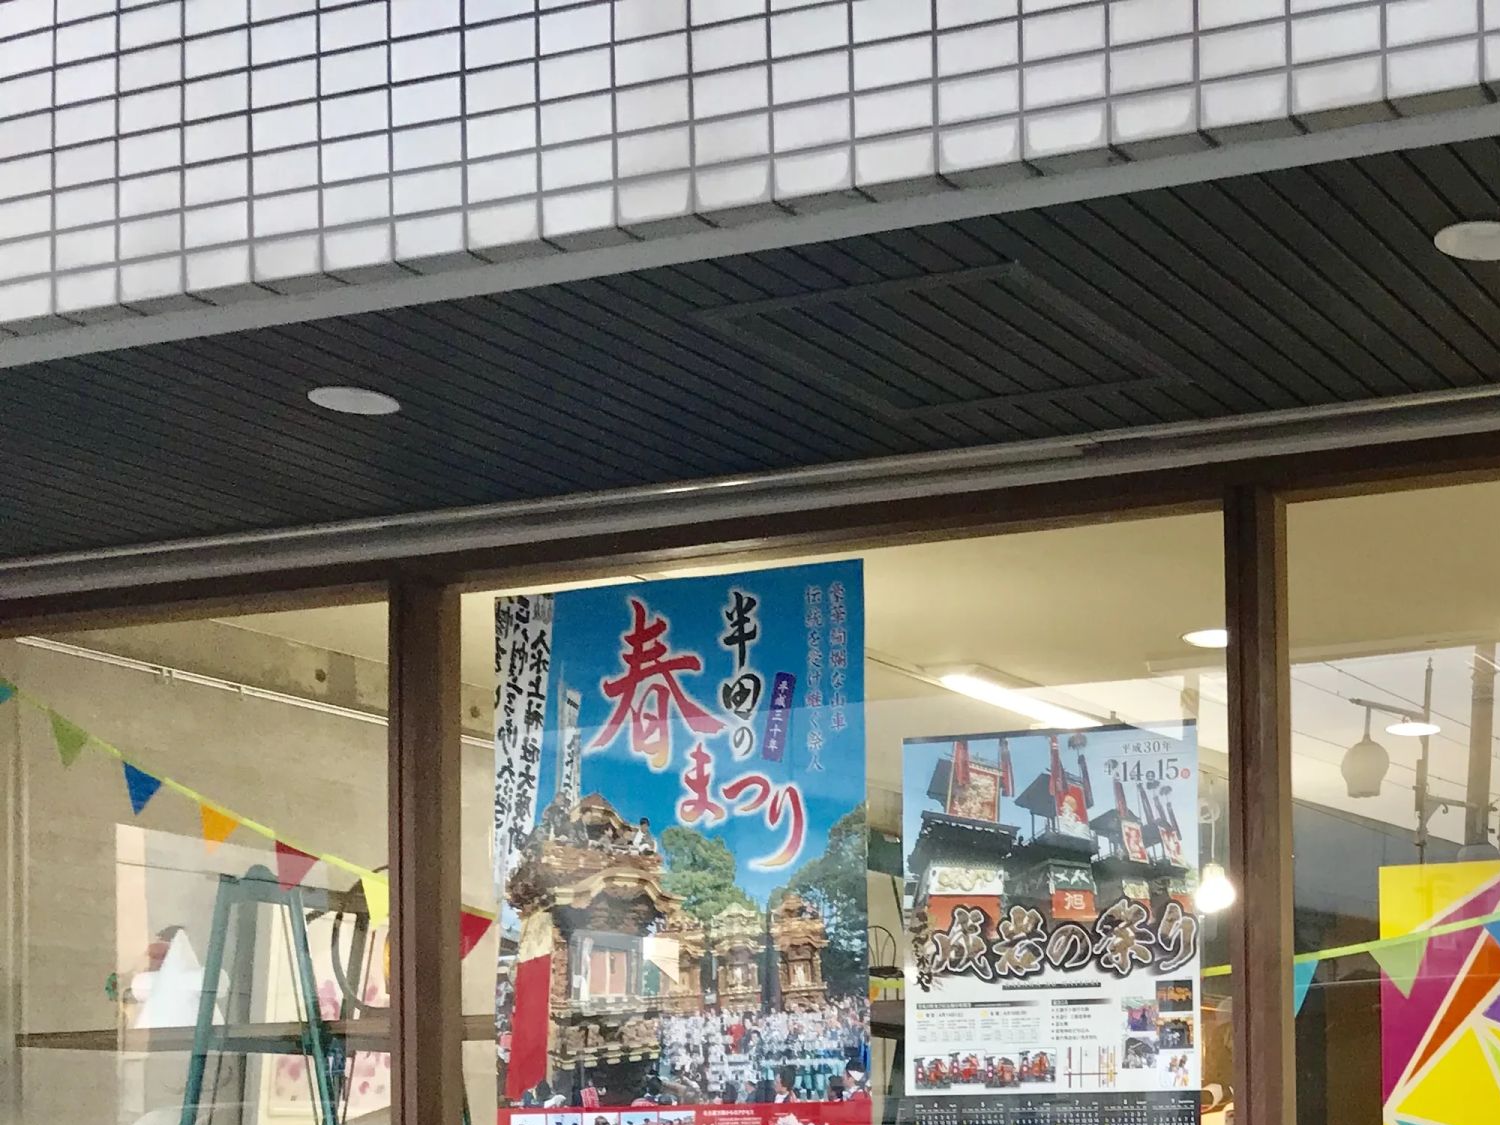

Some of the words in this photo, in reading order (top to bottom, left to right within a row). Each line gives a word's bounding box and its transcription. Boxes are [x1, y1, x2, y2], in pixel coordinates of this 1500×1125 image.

[590, 599, 728, 769] 春
[680, 742, 805, 868] まつり
[722, 591, 762, 757] 半田の
[767, 680, 790, 752] 平成三十年
